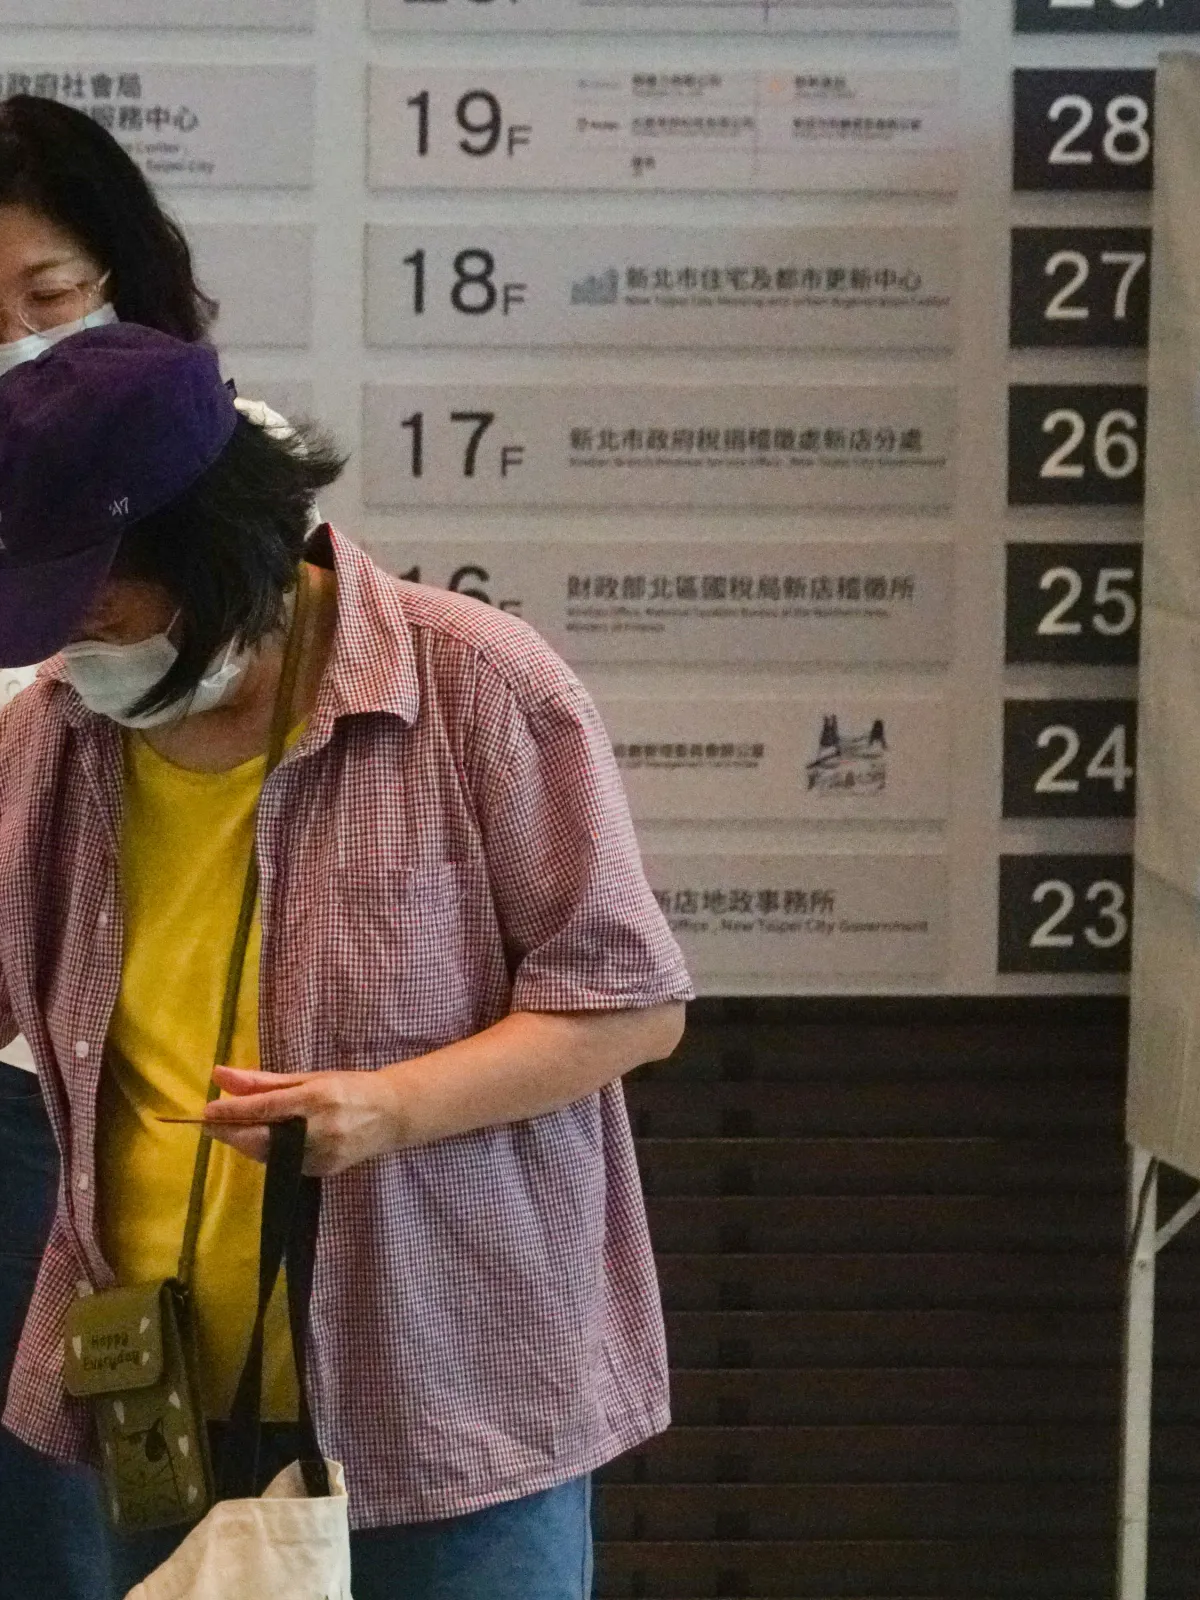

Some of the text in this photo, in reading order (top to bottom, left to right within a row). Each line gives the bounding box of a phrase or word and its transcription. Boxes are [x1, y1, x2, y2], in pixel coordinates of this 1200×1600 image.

[404, 90, 534, 157] 19F
[1047, 95, 1150, 164] 28
[402, 248, 526, 315] 18F
[1044, 251, 1146, 320] 27
[400, 411, 526, 478] 17F
[1040, 410, 1138, 478] 26
[1036, 567, 1135, 636] 25
[1034, 725, 1133, 792] 24
[1029, 880, 1127, 947] 23
